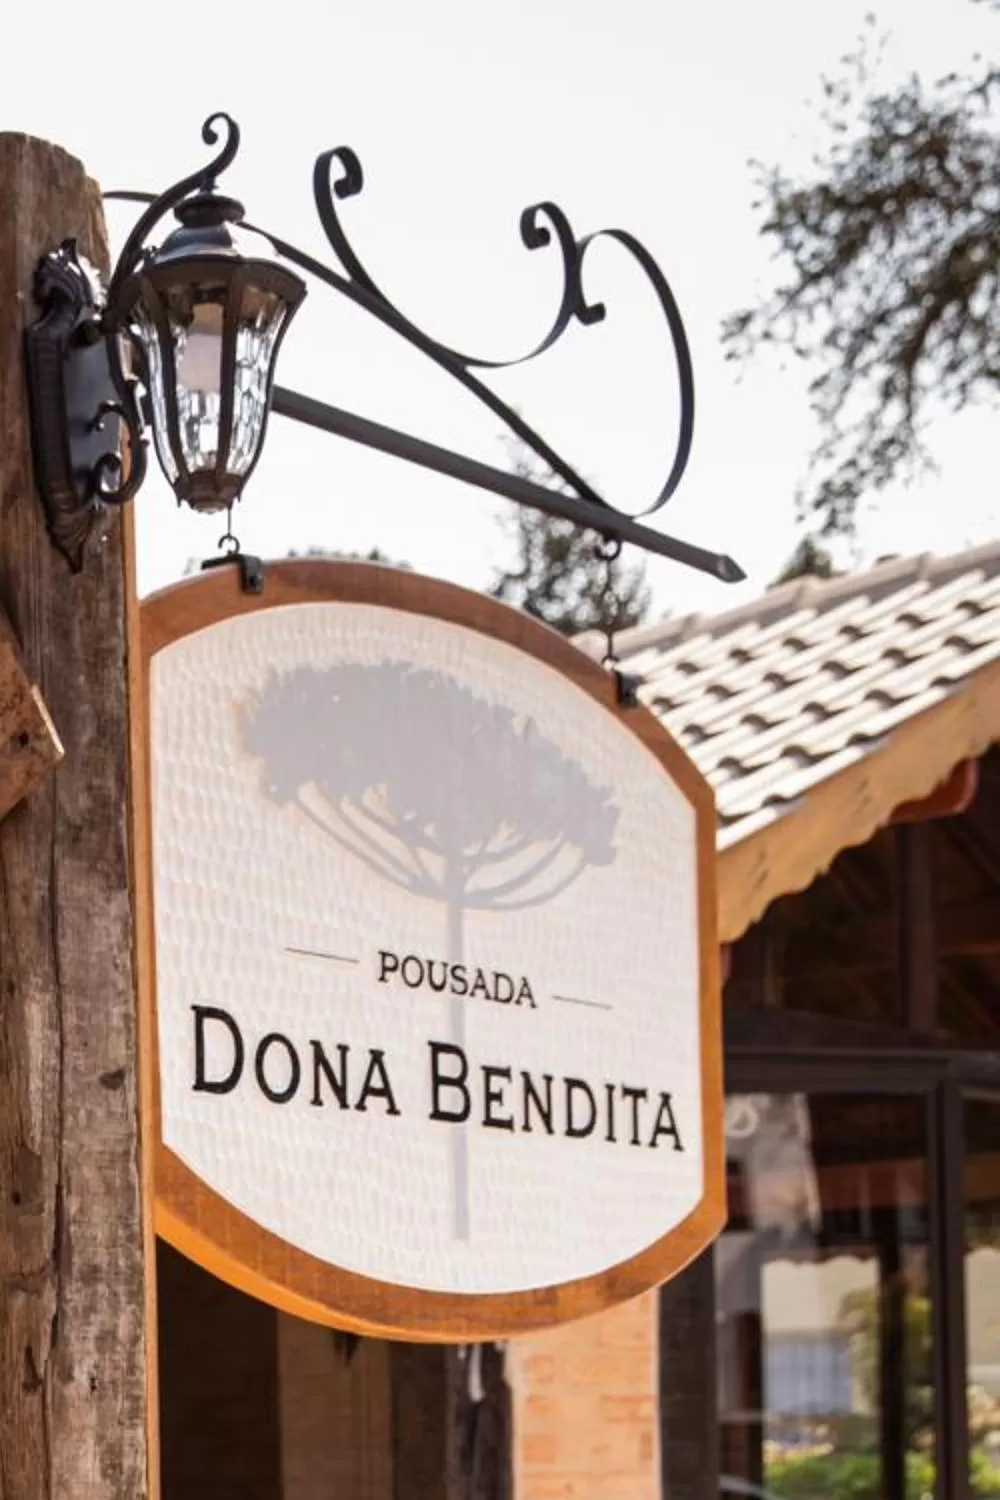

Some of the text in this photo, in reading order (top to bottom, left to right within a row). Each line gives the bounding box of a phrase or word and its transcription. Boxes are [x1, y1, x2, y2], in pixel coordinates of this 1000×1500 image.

[377, 950, 538, 1009] POUSADA
[190, 1004, 685, 1152] DONA BENDITA
